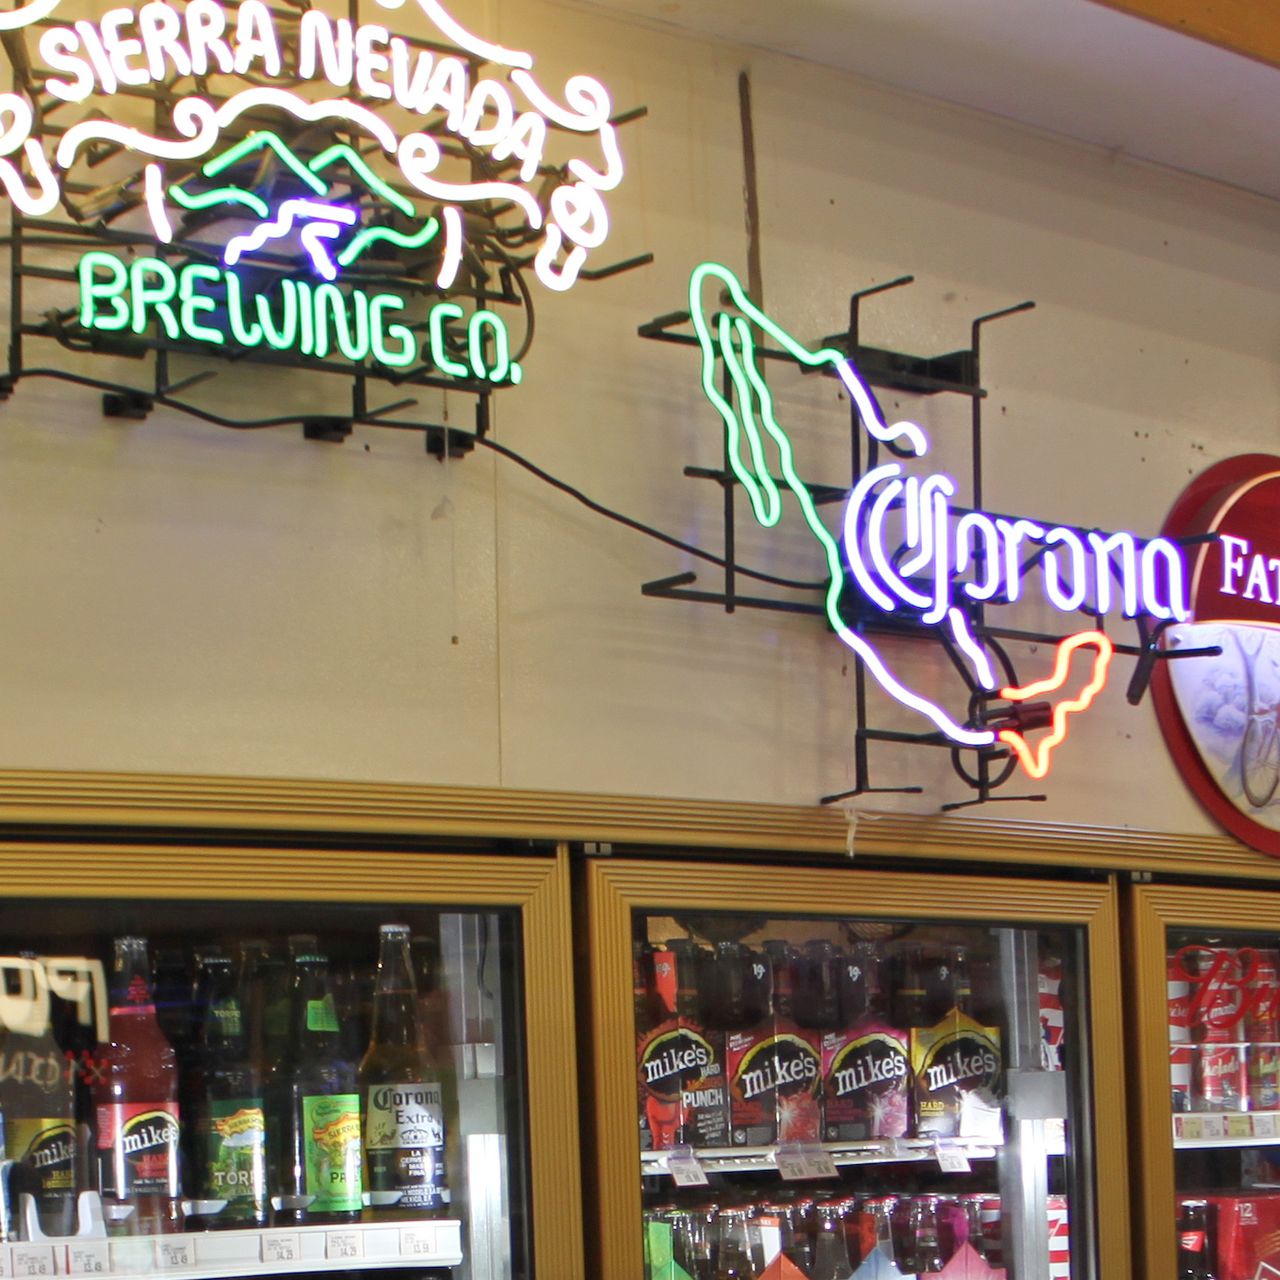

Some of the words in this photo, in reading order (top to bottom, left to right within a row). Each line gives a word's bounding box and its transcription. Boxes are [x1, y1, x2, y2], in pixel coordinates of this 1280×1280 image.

[39, 0, 279, 102] SIERRA
[300, 9, 547, 181] NEVADA
[79, 252, 415, 367] BREWING
[429, 303, 523, 384] CO.
[845, 462, 1191, 624] Corona
[645, 1045, 707, 1084] mike's
[742, 1052, 817, 1099] mike's
[834, 1051, 908, 1097] mike's
[926, 1051, 997, 1093] mike's
[373, 1086, 441, 1114] Corona
[682, 1088, 724, 1109] PUNCH
